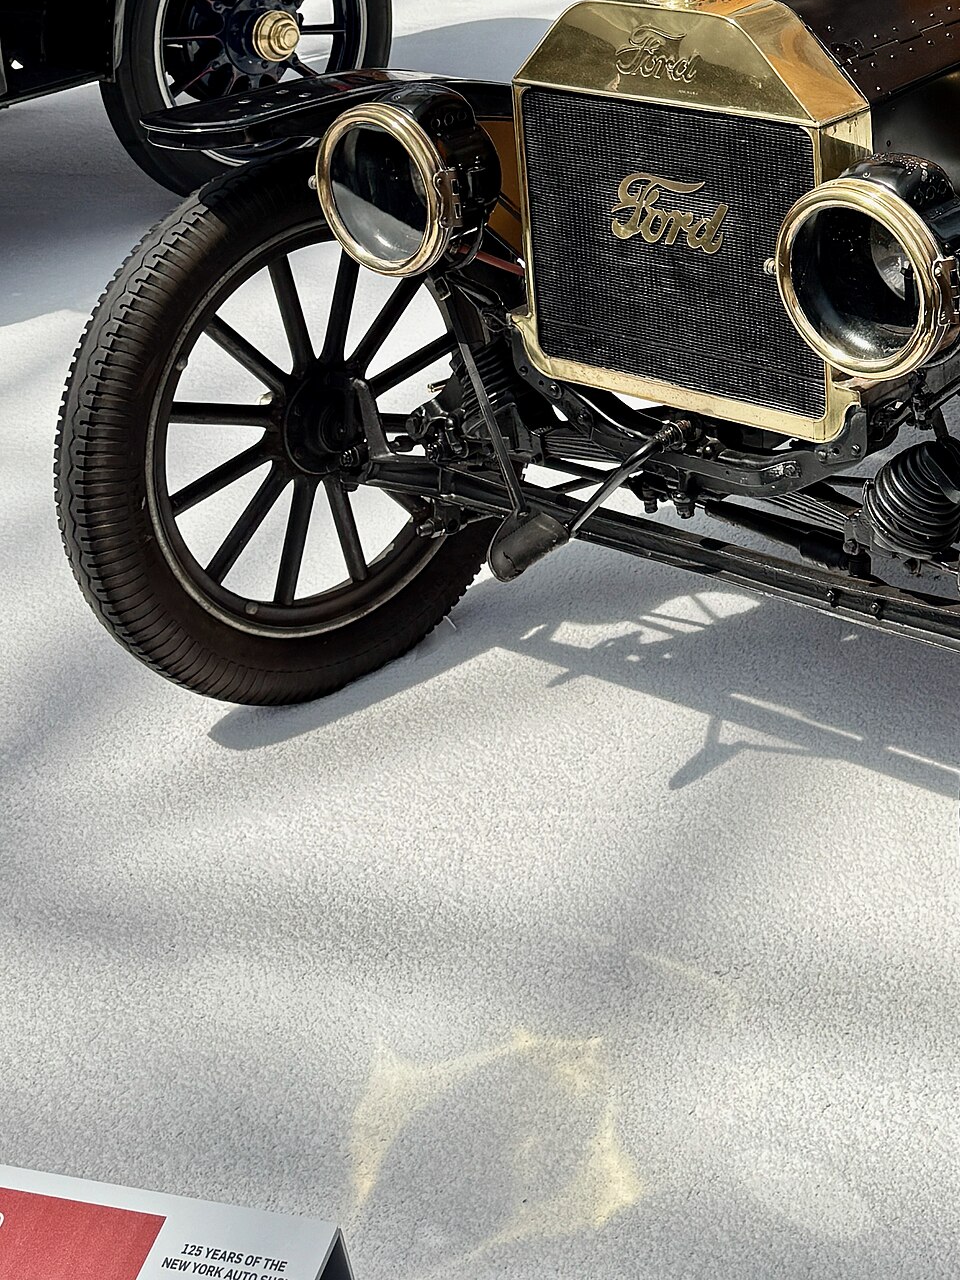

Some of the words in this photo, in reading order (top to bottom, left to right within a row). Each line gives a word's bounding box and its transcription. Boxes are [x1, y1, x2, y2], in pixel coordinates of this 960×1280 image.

[614, 24, 703, 83] Ford
[611, 172, 728, 254] Ford
[161, 1257, 191, 1272] NEW
[192, 1262, 225, 1278] YORK
[223, 1269, 258, 1280] AUTO
[181, 1244, 203, 1257] 125
[205, 1247, 244, 1264] YEARS
[244, 1255, 262, 1267] OF
[263, 1258, 288, 1272] THE
